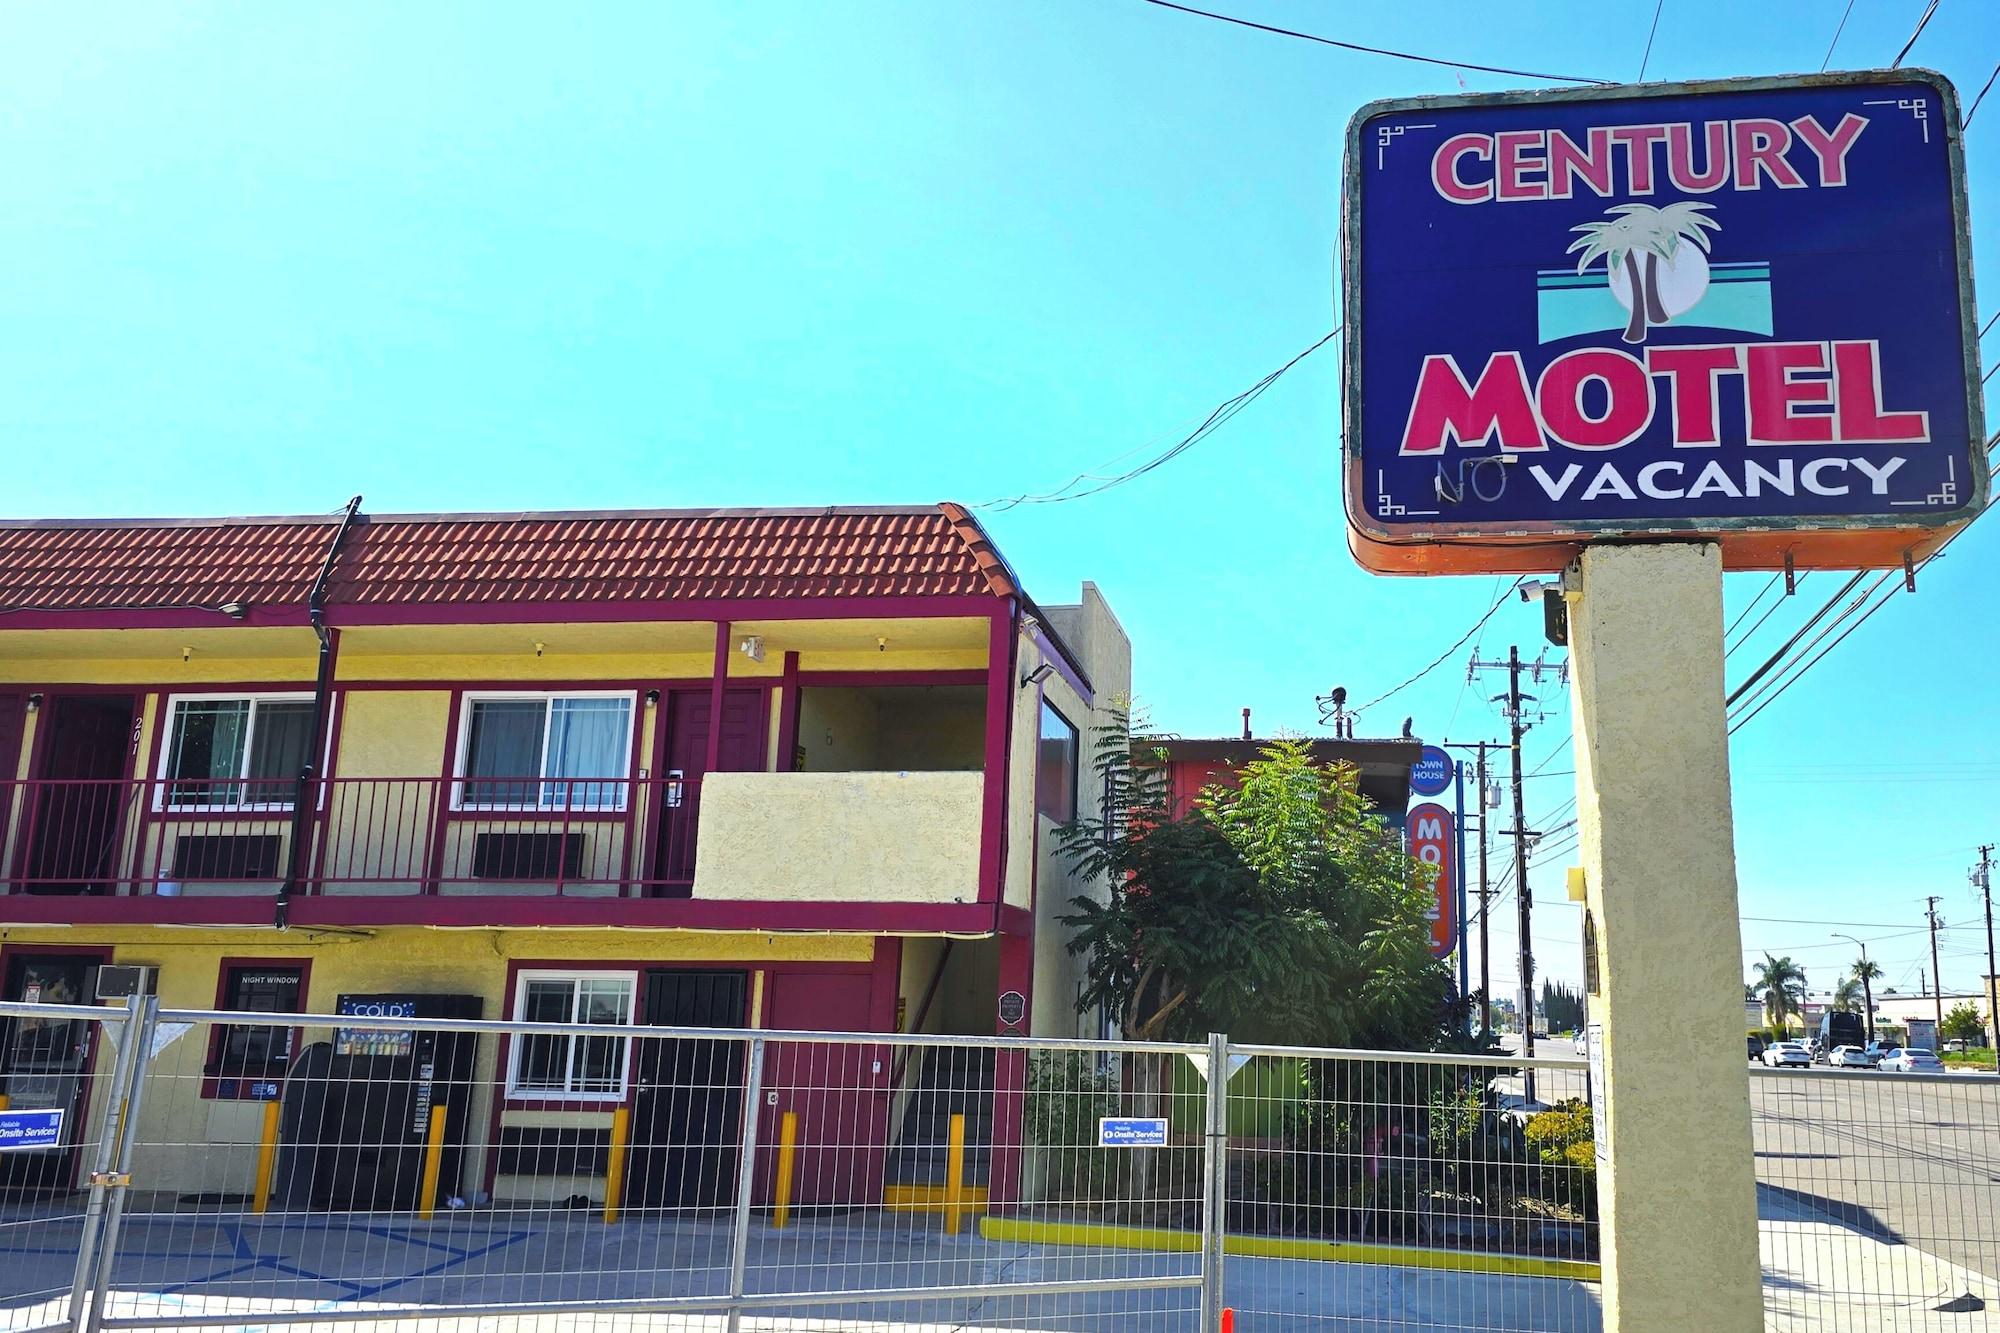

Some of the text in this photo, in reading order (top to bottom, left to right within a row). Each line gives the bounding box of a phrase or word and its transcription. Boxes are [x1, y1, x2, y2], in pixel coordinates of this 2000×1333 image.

[1431, 112, 1870, 205] CENTURY
[1399, 339, 1931, 456] MOTEL
[1436, 456, 1907, 502] NO VACANCY
[133, 717, 143, 755] 201
[1413, 771, 1445, 779] HOUSE
[242, 976, 299, 984] NIGHT WINDOW
[0, 1127, 56, 1138] Onsite Services
[1114, 1130, 1162, 1138] Onsite Services
